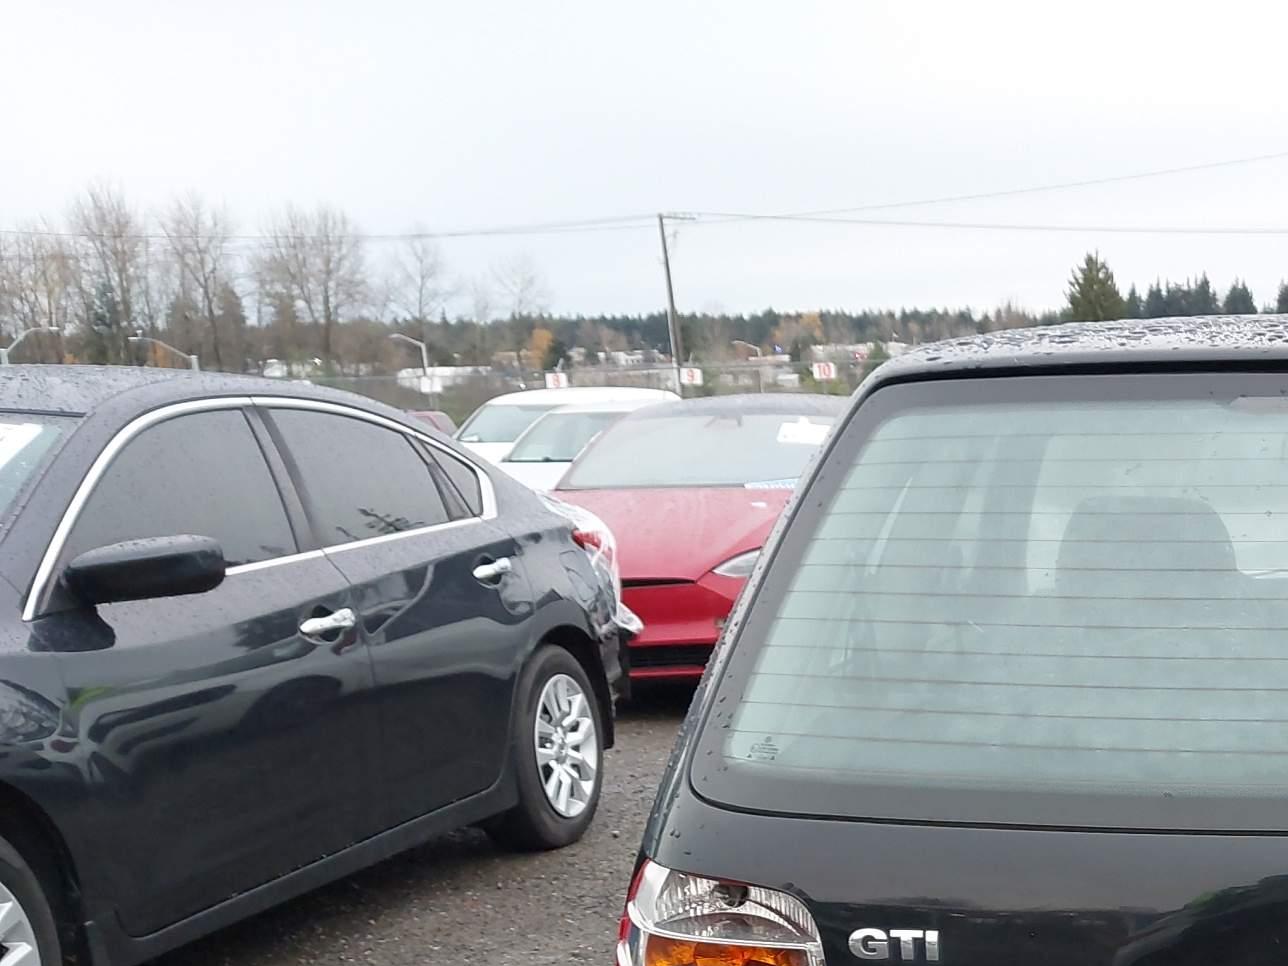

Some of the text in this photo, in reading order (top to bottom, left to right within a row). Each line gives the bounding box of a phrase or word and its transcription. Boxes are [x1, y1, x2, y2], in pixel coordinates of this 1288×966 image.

[686, 368, 696, 383] 9
[816, 363, 832, 378] 10
[848, 927, 940, 961] GTI
